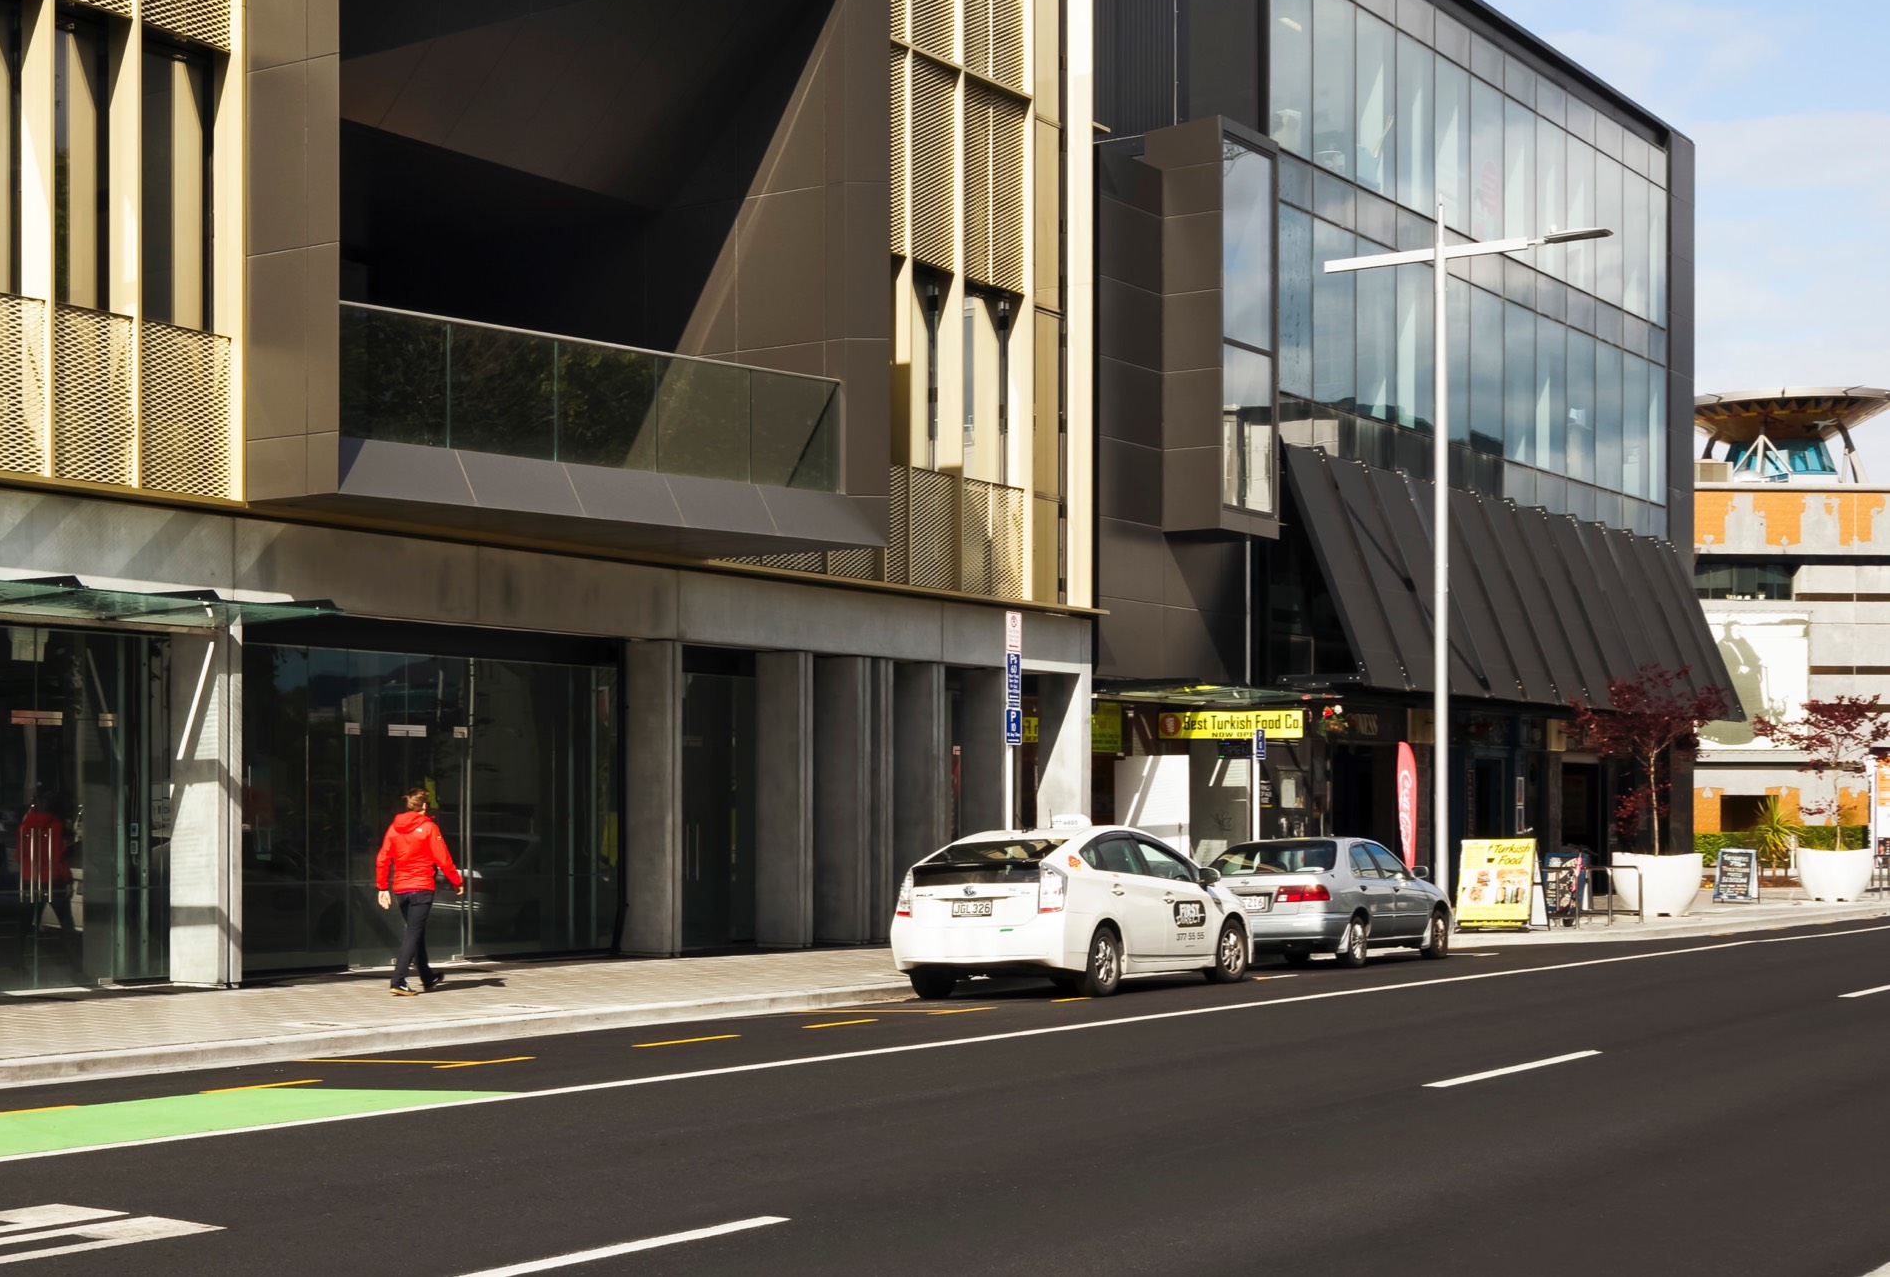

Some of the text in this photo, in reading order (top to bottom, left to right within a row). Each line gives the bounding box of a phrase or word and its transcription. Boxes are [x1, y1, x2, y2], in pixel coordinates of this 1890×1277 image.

[1010, 711, 1017, 722] P
[1183, 715, 1208, 730] Best
[1211, 715, 1252, 730] Turkish
[1255, 714, 1282, 730] Food
[1285, 714, 1303, 729] Co.
[1494, 844, 1532, 854] Turkish
[1498, 855, 1525, 865] Food
[1176, 931, 1205, 941] 377 55 55
